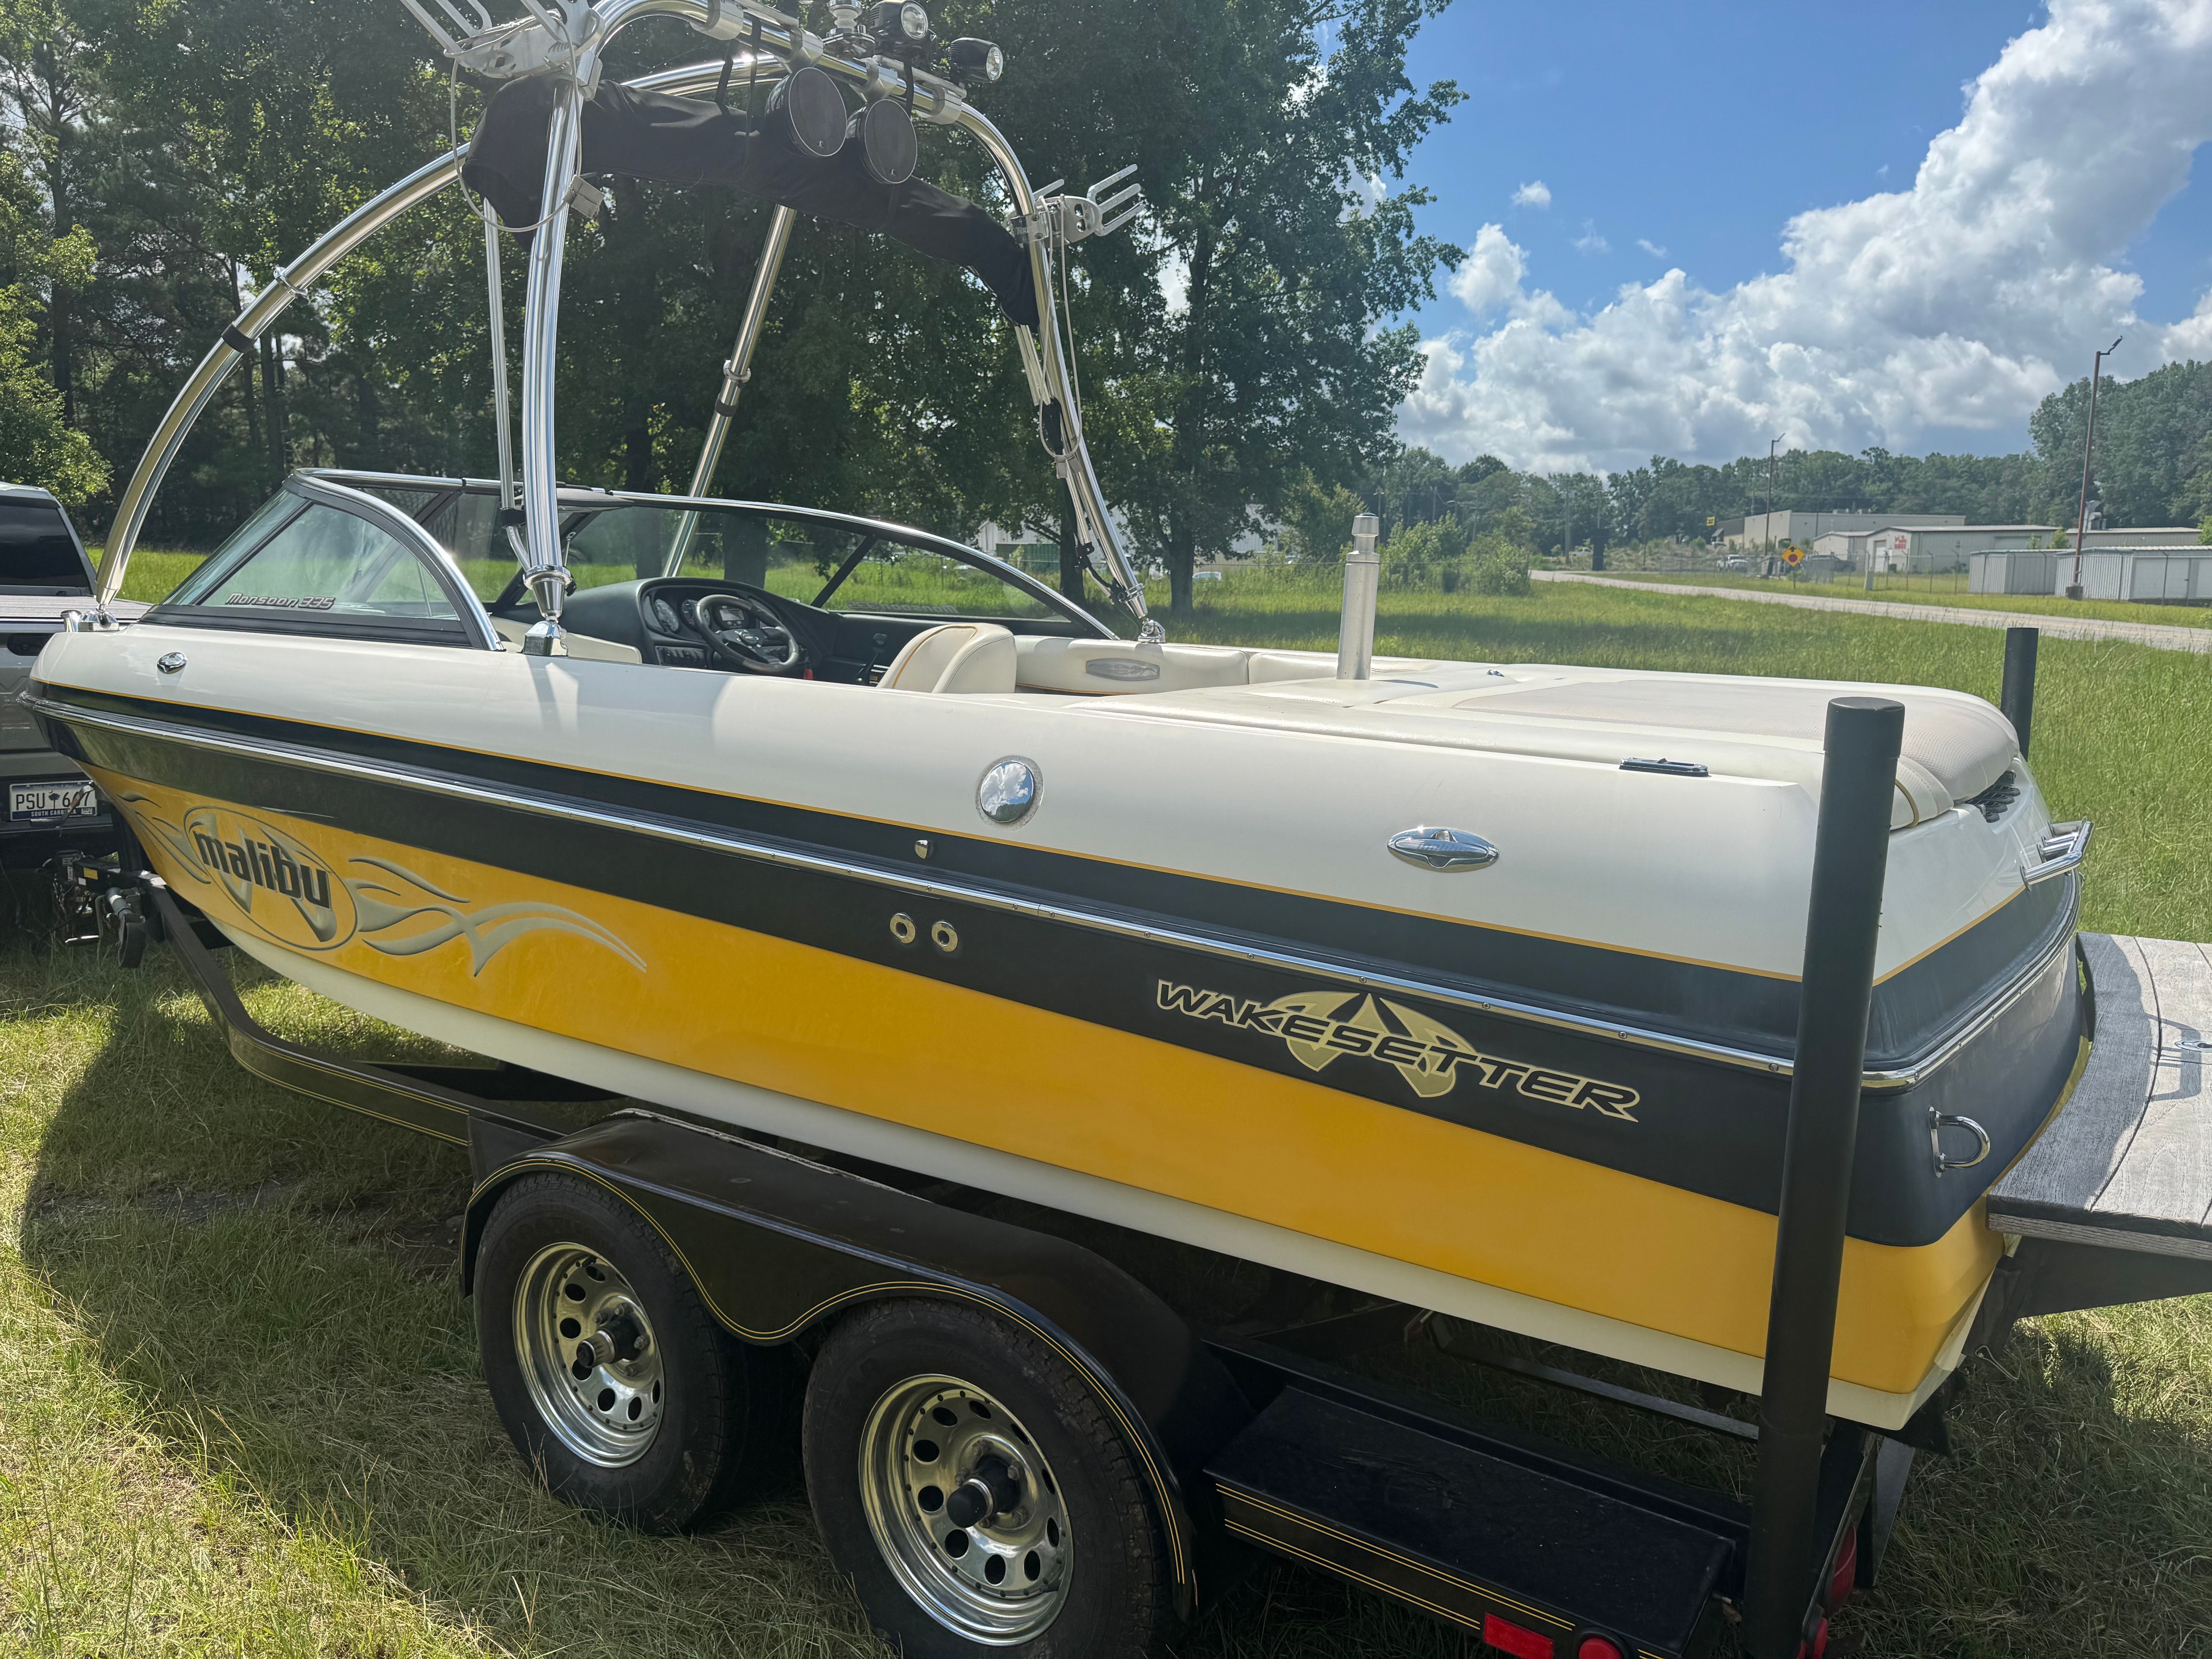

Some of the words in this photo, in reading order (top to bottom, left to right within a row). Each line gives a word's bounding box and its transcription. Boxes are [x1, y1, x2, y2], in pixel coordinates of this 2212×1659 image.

[225, 593, 299, 608] Monsoon
[298, 596, 335, 610] 335
[16, 793, 45, 811] PSU
[193, 831, 332, 909] malibu
[1157, 979, 1640, 1122] WAKESETTER
